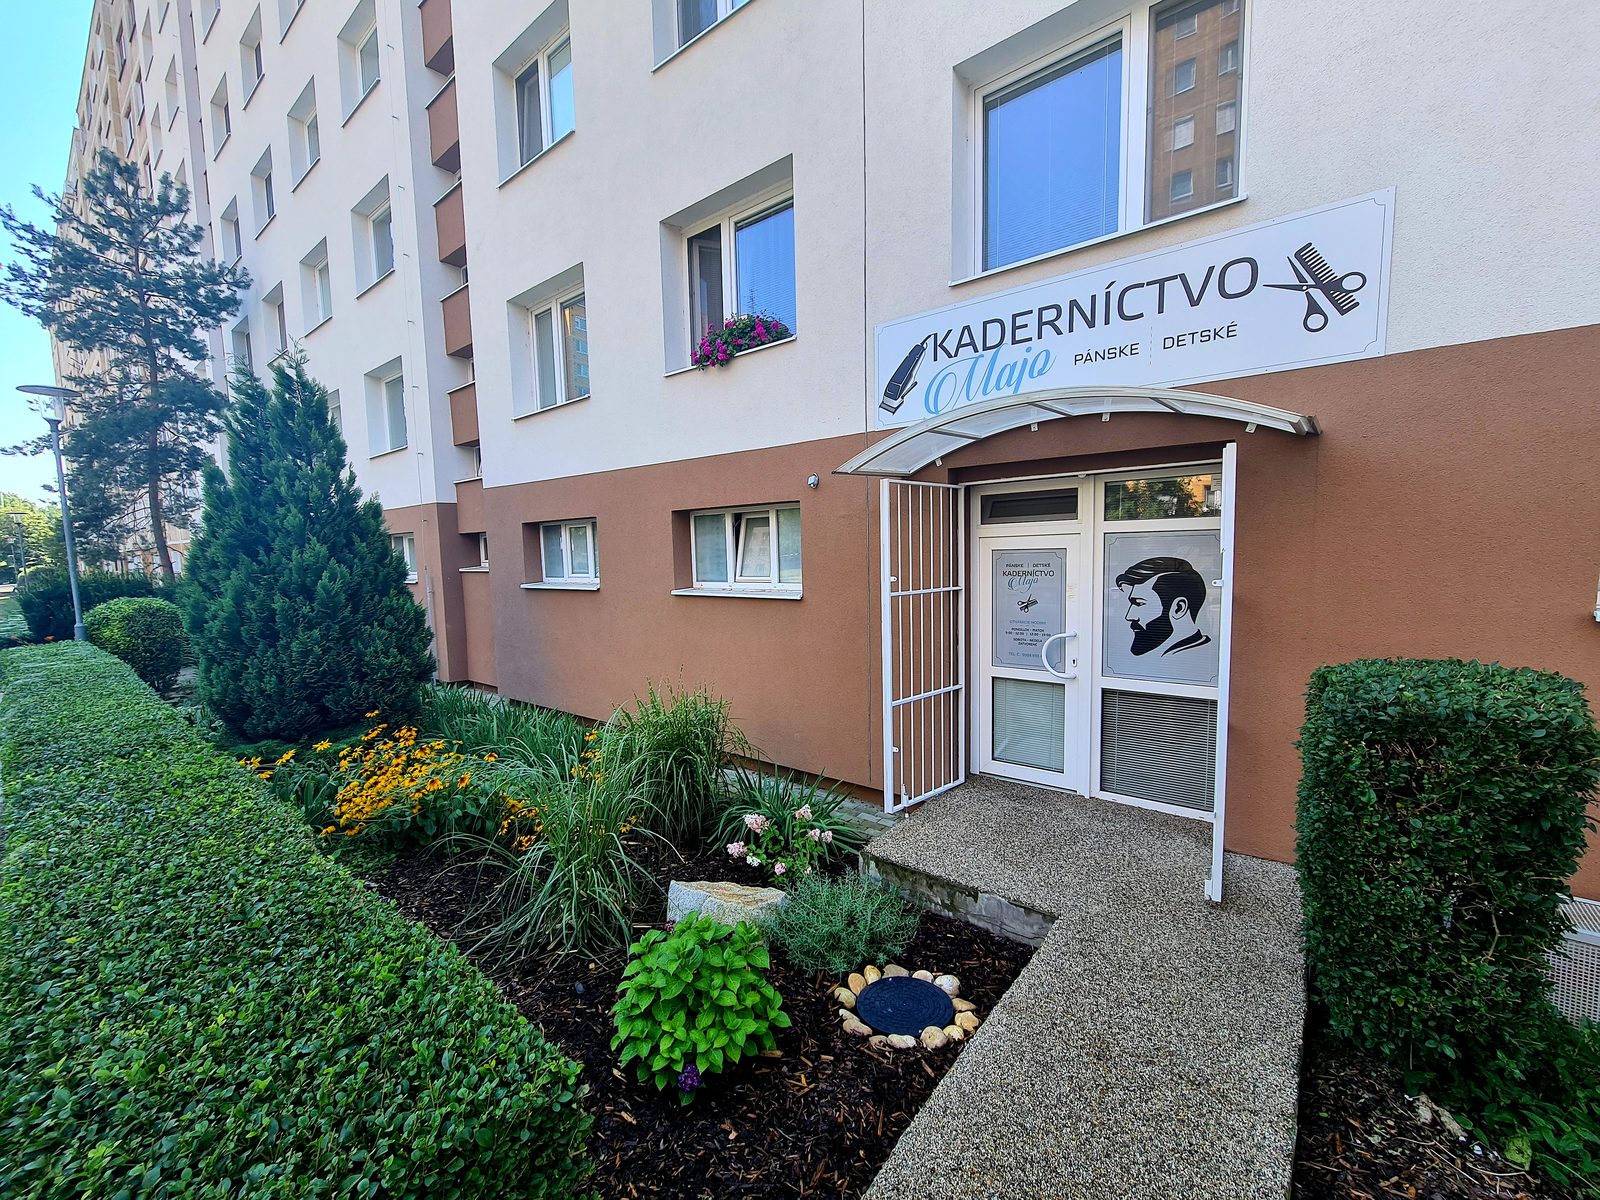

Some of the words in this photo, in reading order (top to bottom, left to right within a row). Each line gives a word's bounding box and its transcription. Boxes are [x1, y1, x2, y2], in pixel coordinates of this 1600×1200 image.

[933, 256, 1260, 363] KADERNÍCTVO
[1073, 342, 1140, 366] PÁNSKE
[1162, 321, 1238, 350] DETSKÉ
[924, 343, 1057, 415] Majo
[1002, 569, 1055, 577] KADERNÍCTVO
